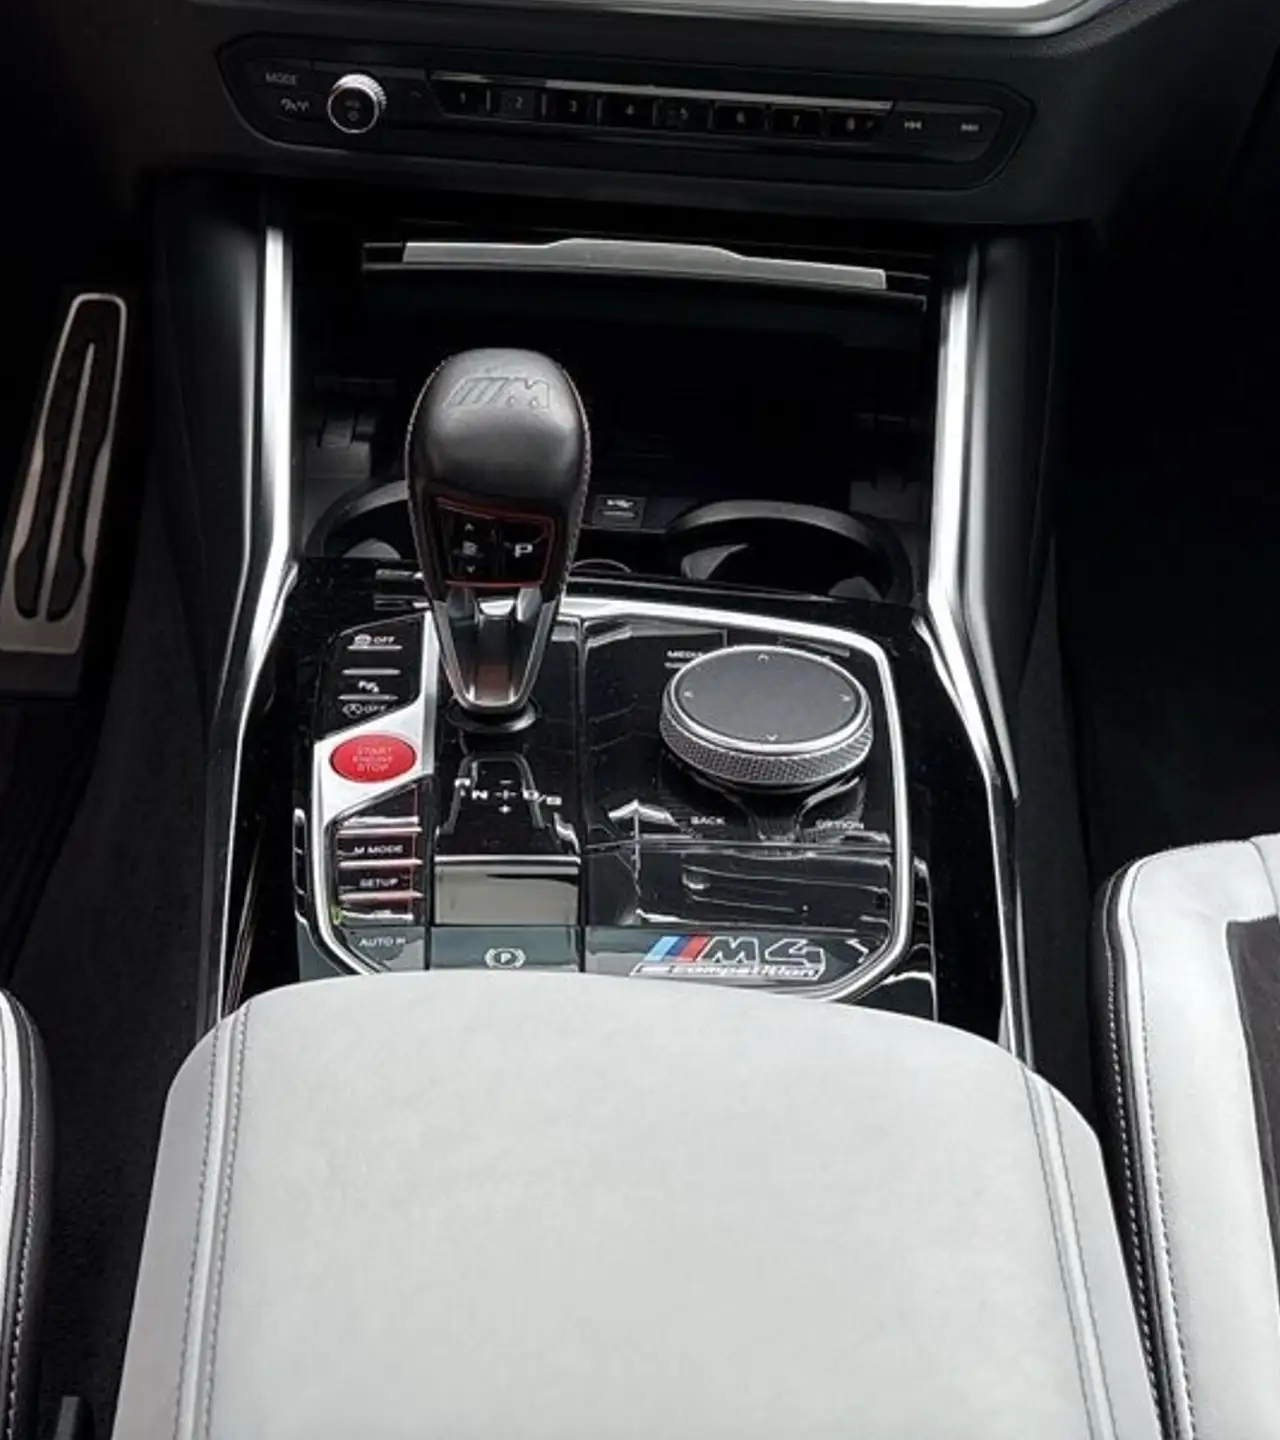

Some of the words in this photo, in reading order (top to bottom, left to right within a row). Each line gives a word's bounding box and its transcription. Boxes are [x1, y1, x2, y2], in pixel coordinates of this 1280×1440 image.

[265, 71, 298, 85] MODE
[515, 543, 533, 558] P
[472, 789, 488, 800] N
[690, 816, 726, 825] BACK
[815, 820, 865, 830] OPTION
[366, 844, 404, 854] MODE
[359, 877, 399, 888] SETUP
[358, 935, 394, 947] AUTO
[694, 936, 826, 966] M4
